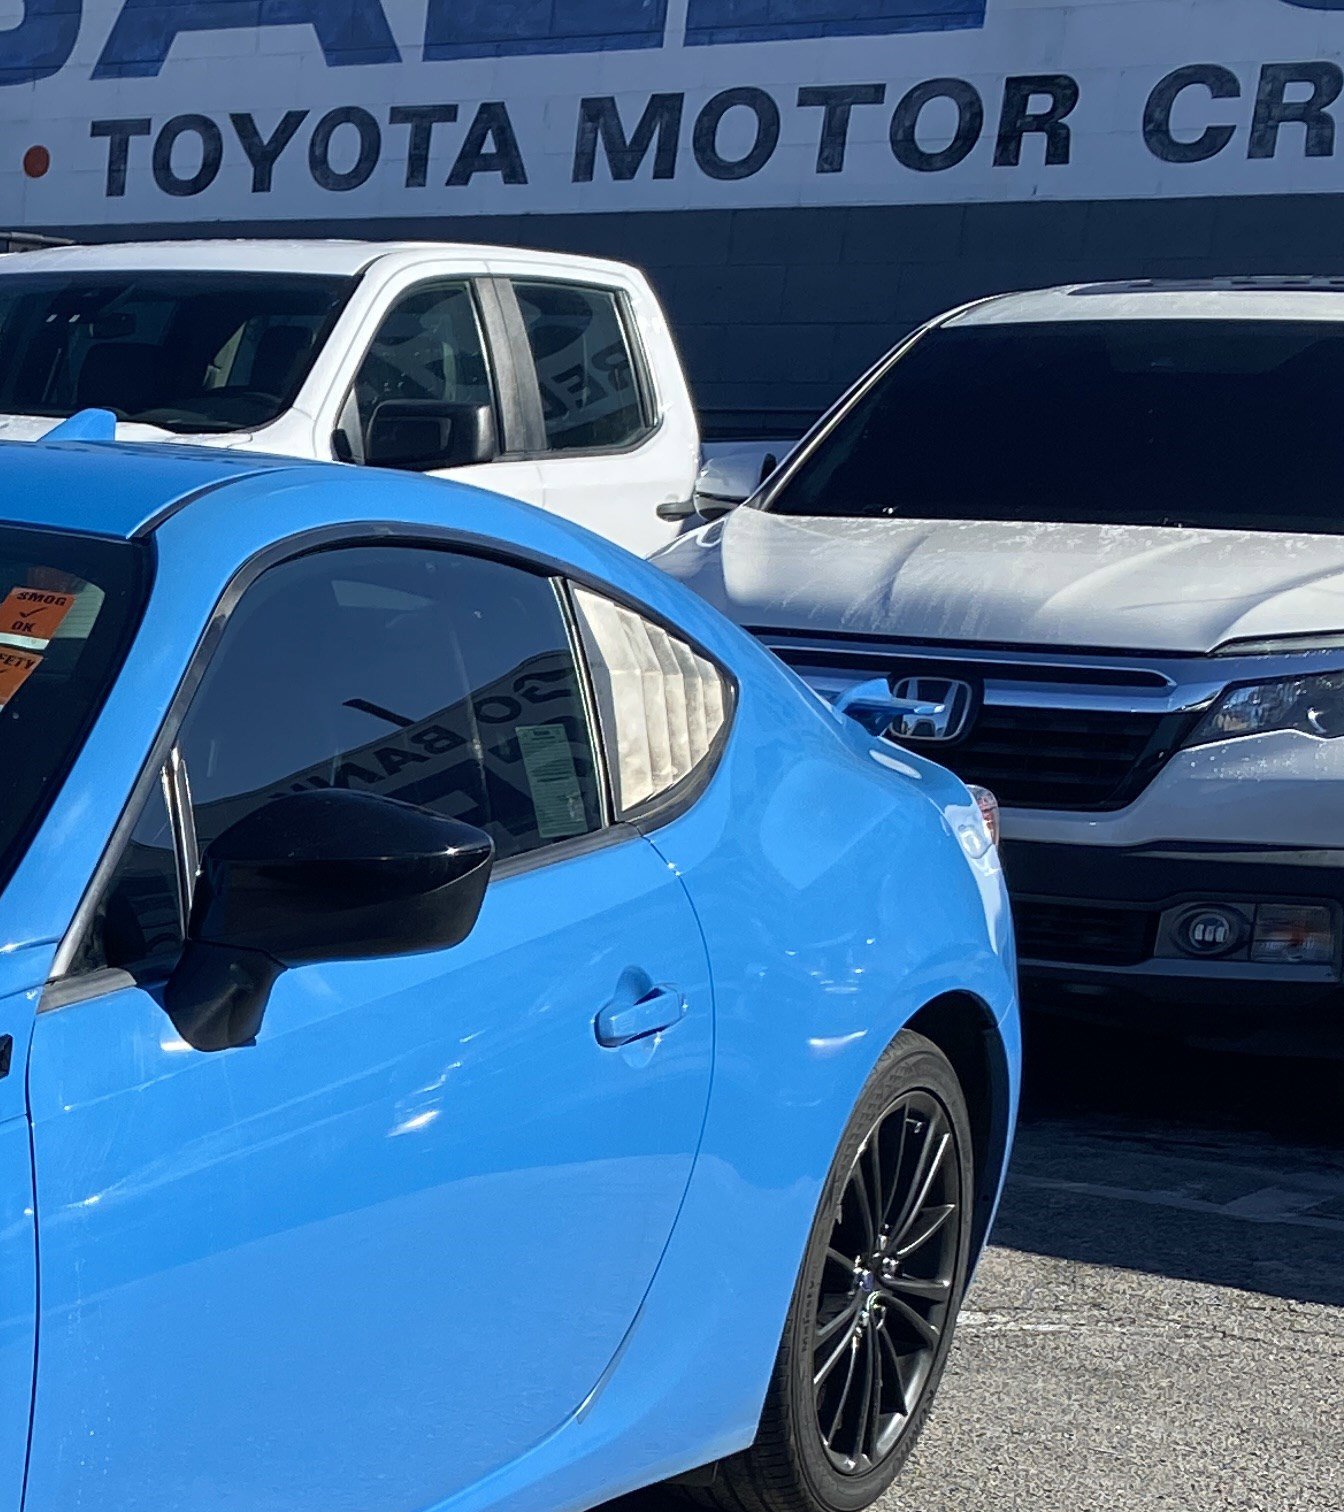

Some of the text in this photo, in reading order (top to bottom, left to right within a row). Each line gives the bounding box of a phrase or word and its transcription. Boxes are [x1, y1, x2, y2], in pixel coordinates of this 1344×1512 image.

[89, 101, 529, 198] TOYOTA
[571, 74, 1080, 184] MOTOR
[1142, 61, 1344, 164] CR
[16, 591, 67, 606] SMOG
[11, 620, 36, 633] OK
